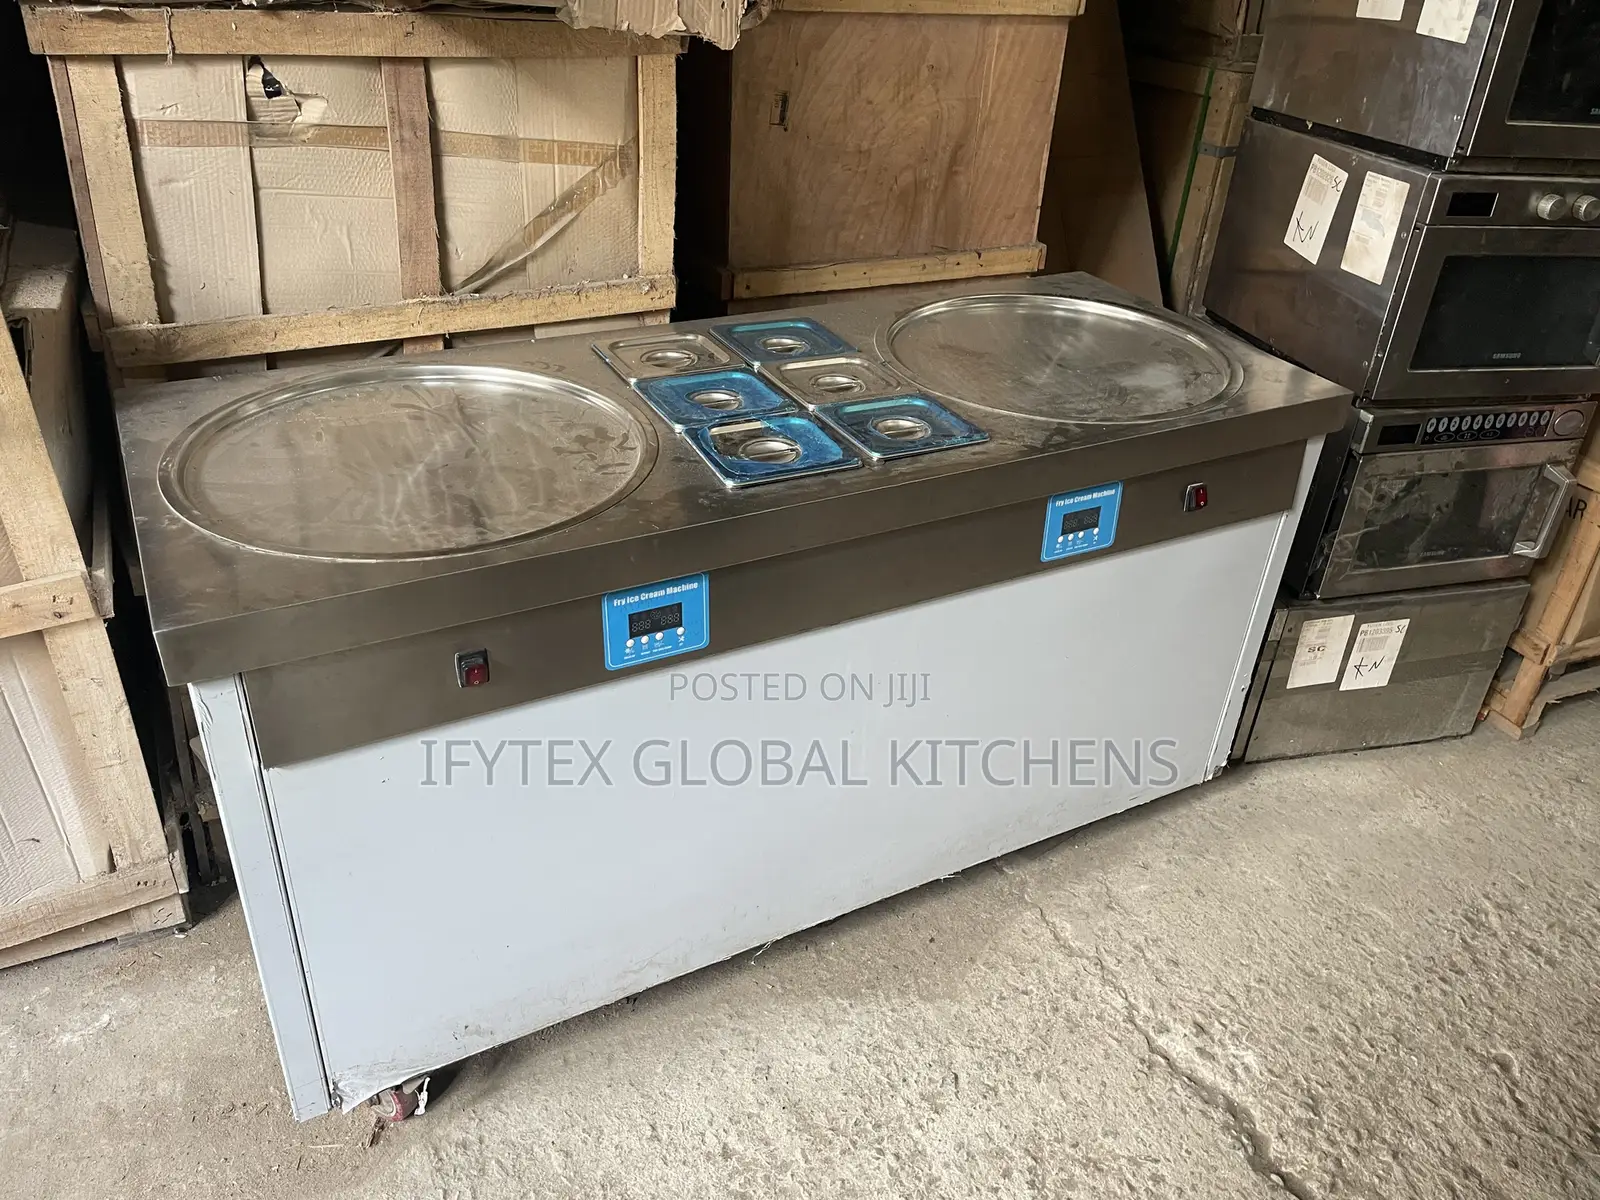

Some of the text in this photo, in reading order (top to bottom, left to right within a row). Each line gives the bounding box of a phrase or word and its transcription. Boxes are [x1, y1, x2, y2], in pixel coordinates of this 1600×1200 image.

[1074, 494, 1092, 502] Cream
[1092, 489, 1115, 499] Machine
[613, 582, 697, 607] Fry Ice Cream Machine
